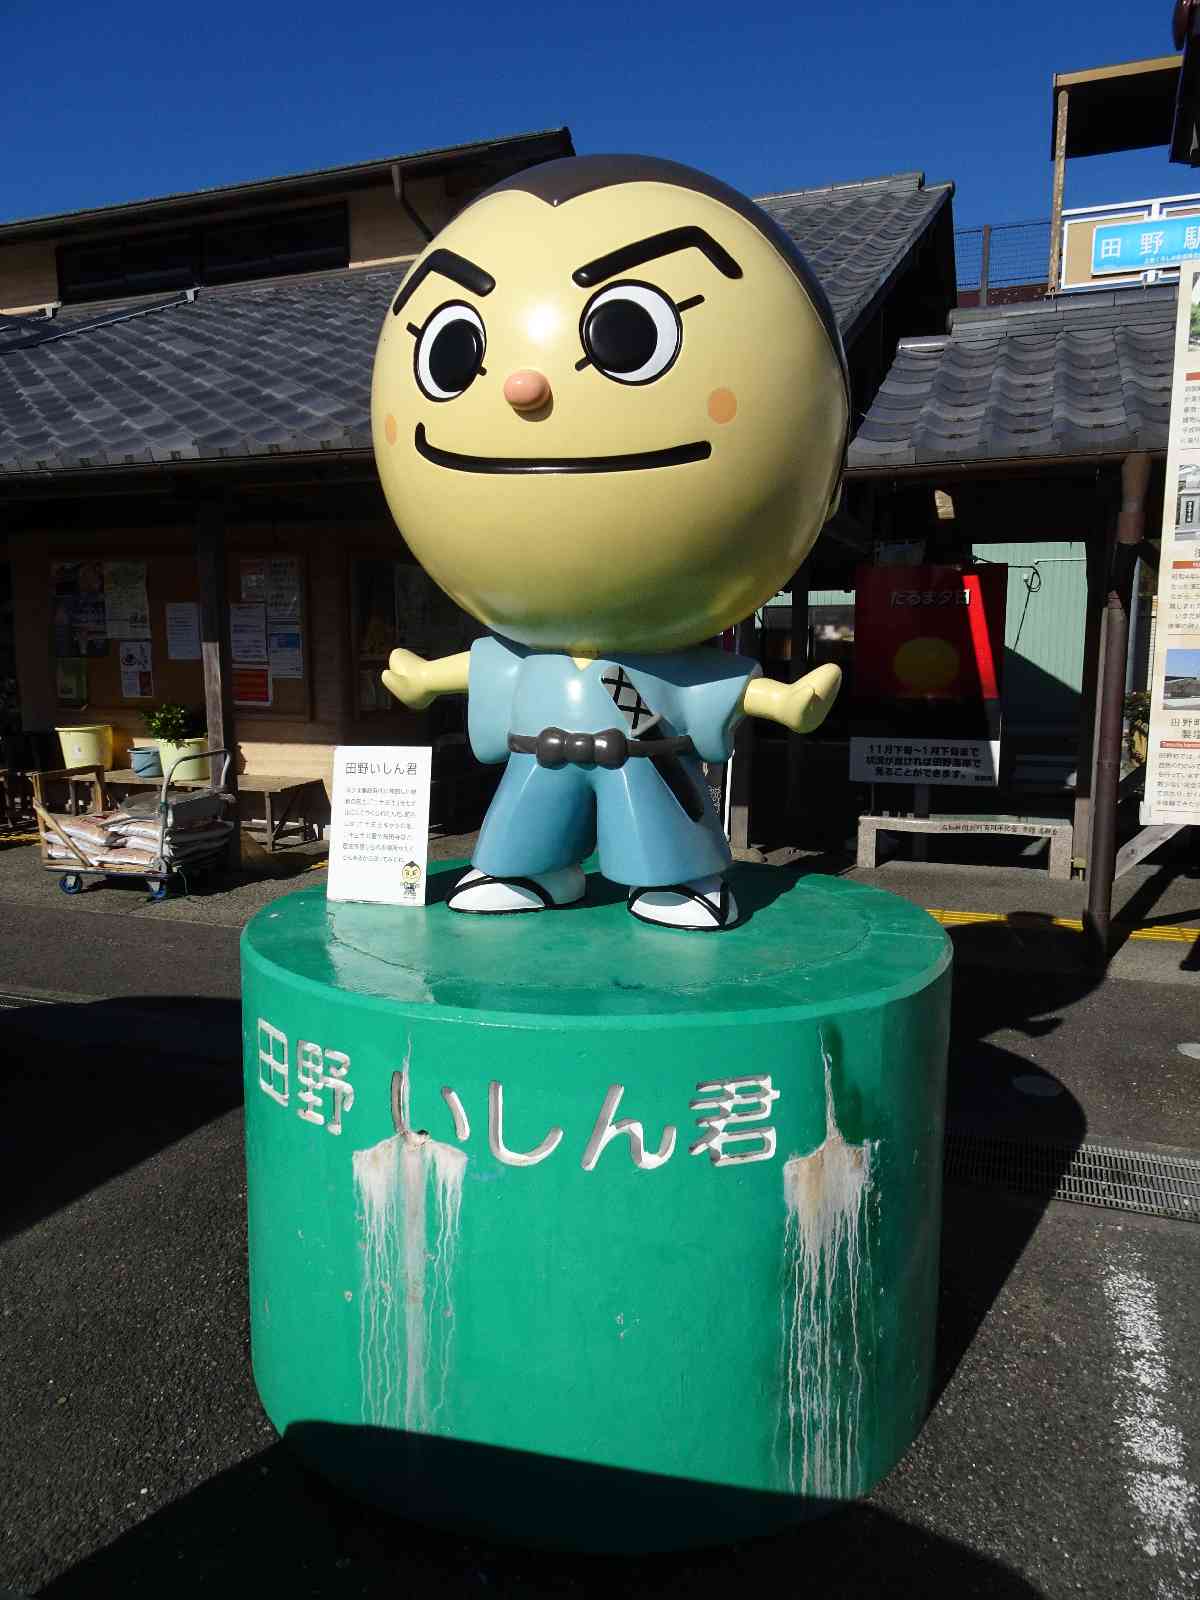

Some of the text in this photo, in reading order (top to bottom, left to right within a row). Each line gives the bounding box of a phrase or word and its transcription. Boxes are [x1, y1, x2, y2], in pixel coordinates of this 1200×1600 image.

[345, 762, 417, 776] 田野いしん君
[257, 1016, 781, 1171] 田野いしん君
